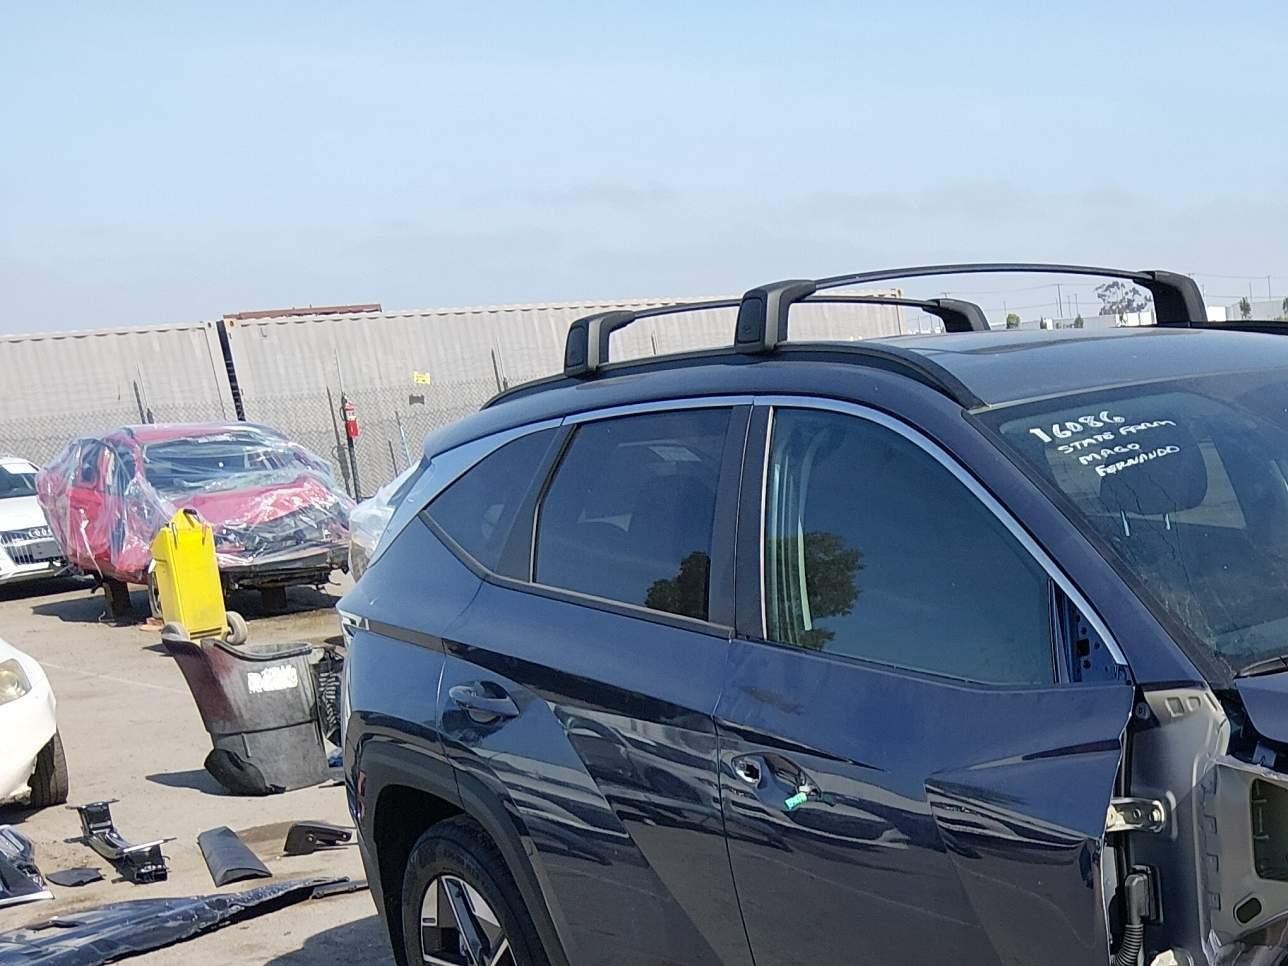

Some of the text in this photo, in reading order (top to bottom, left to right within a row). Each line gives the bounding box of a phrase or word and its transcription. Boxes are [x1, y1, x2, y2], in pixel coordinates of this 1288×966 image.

[1029, 411, 1126, 443] 16086
[1057, 431, 1115, 455] STATE
[1078, 443, 1141, 465] MAGO
[1095, 445, 1181, 477] FERNANDO
